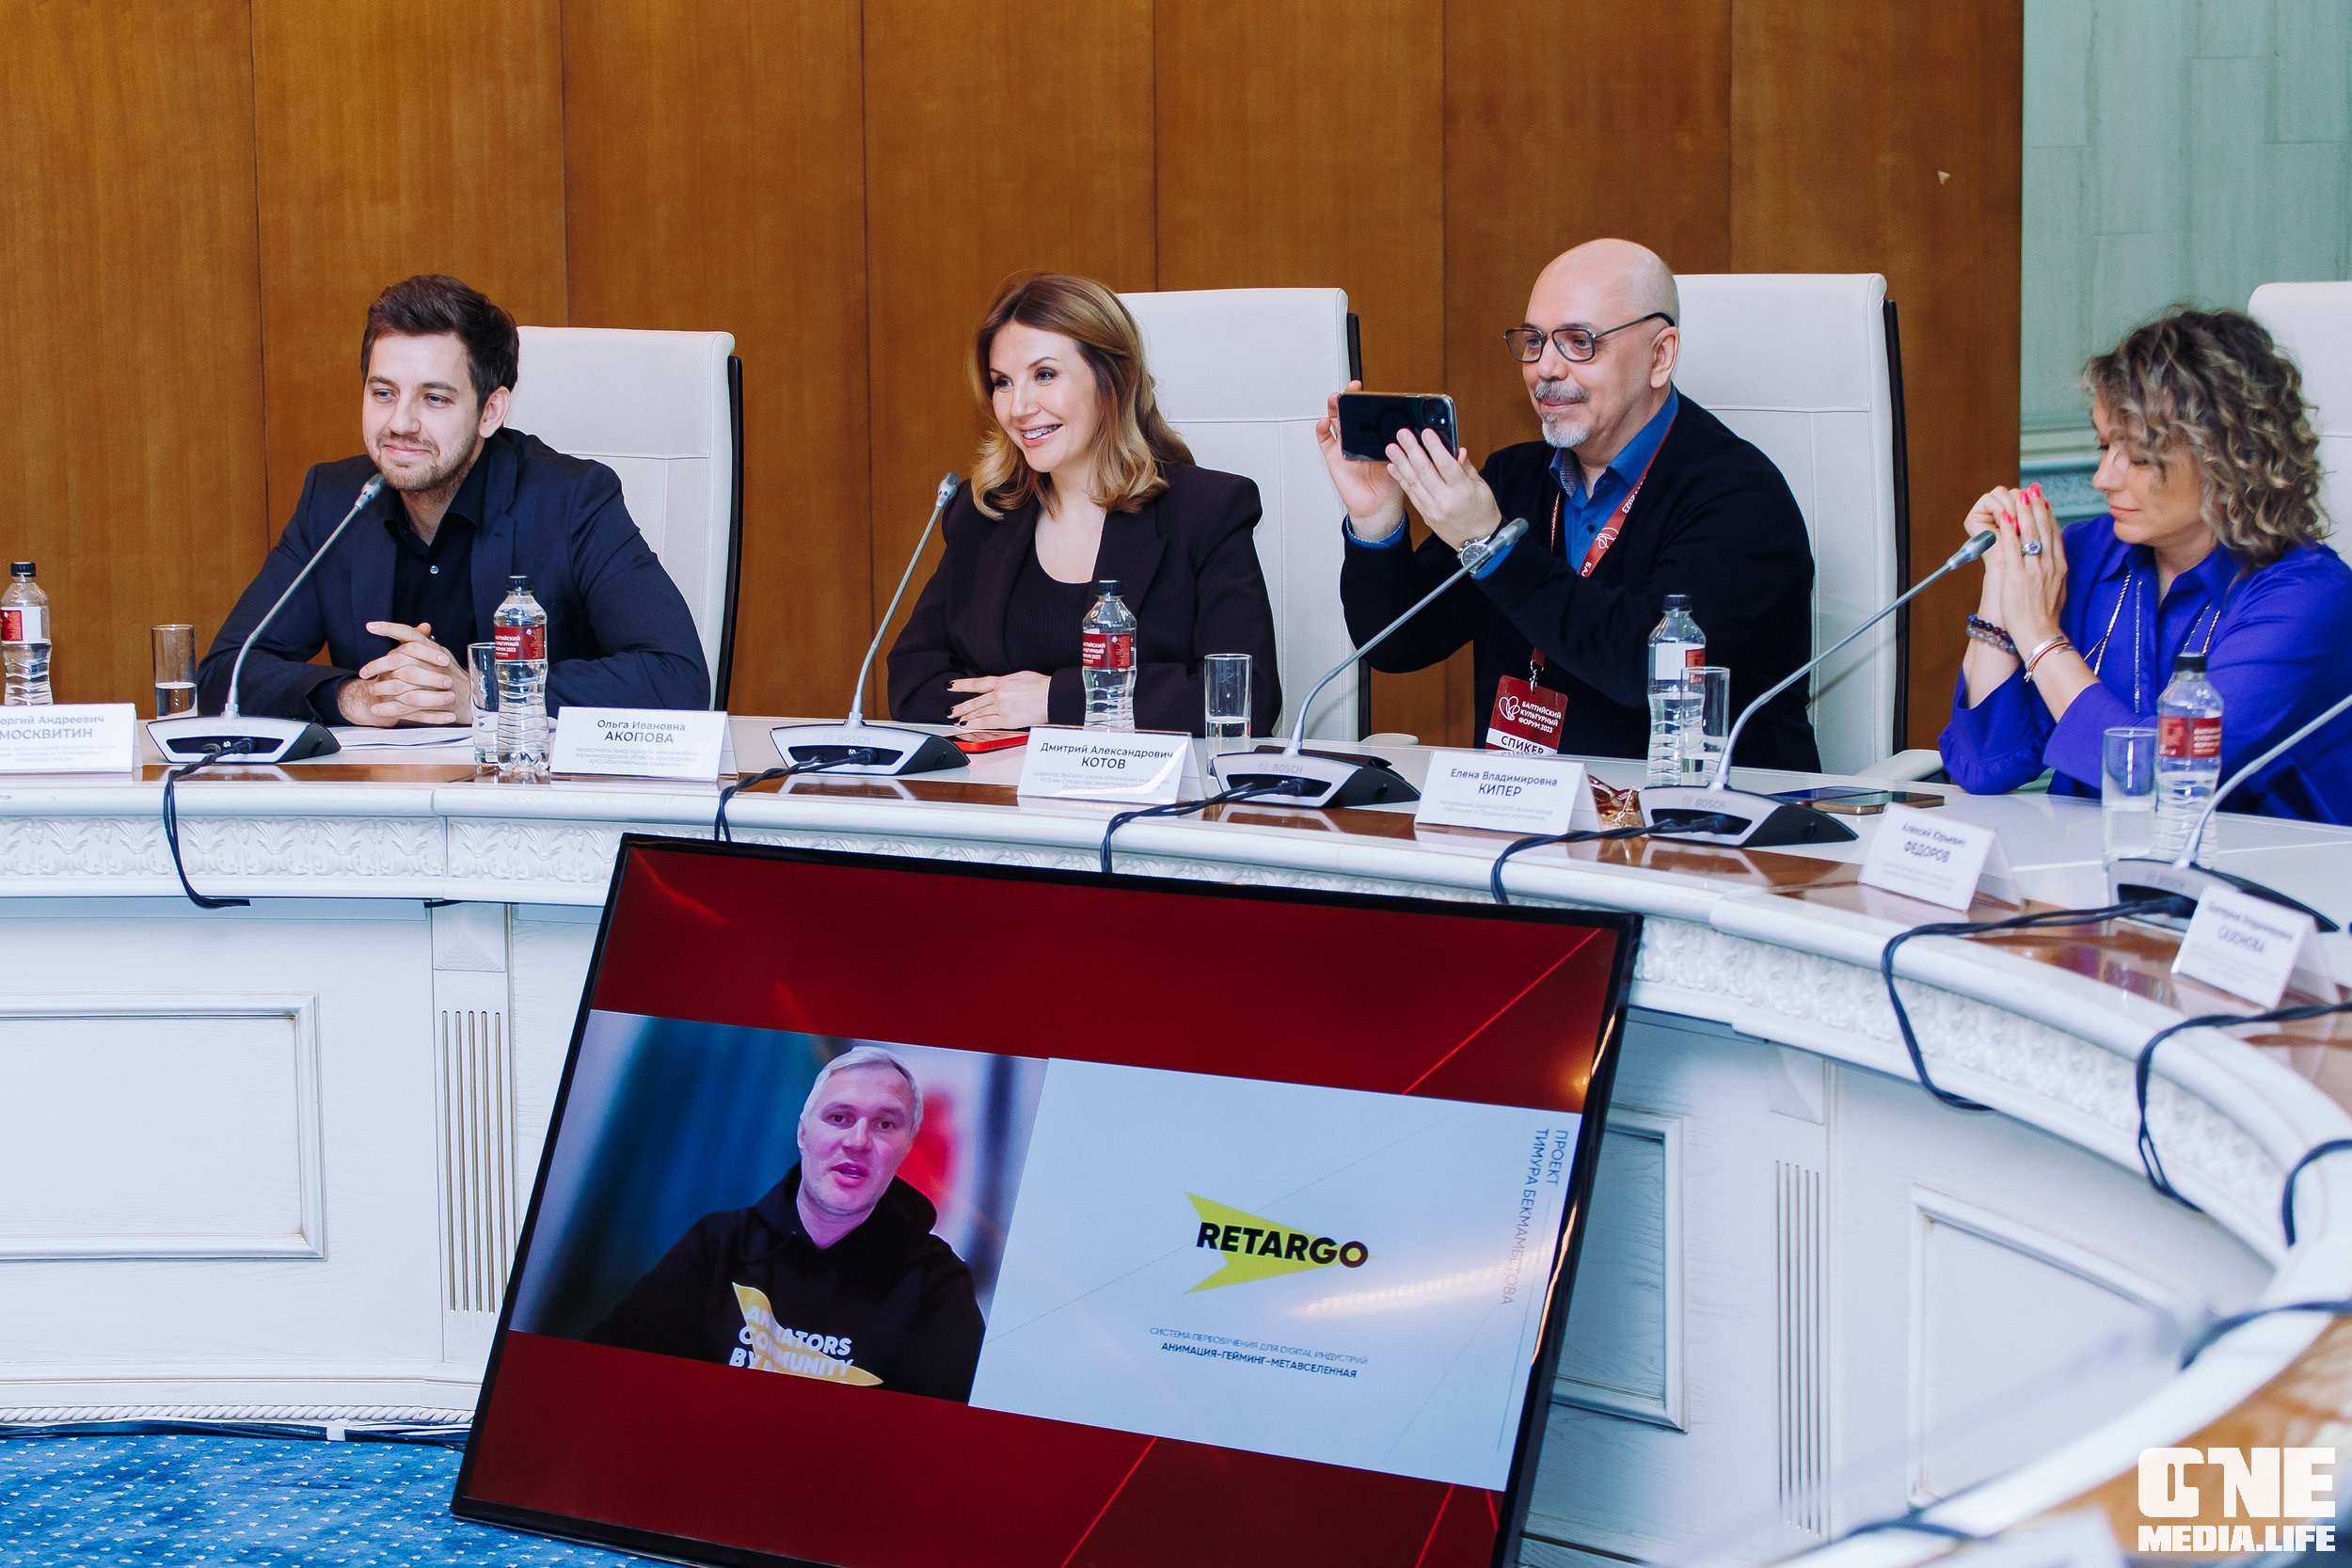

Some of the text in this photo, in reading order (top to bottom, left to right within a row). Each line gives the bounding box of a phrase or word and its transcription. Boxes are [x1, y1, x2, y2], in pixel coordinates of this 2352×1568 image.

[1519, 708, 1559, 727] КУЛЬТУРНЫЙ
[1521, 701, 1562, 720] БАЛТИЙСКИЙ
[0, 716, 104, 726] оргий Андреевич
[596, 720, 686, 732] Ольга Ивановна
[1518, 717, 1553, 734] ФОРУМ 2023
[0, 728, 93, 740] МОСКВИТИН
[604, 731, 675, 744] АКОПОВА
[837, 734, 871, 744] BOSCH
[1040, 742, 1174, 759] Дмитрий Александрович
[1081, 756, 1126, 769] КОТОВ
[1272, 763, 1304, 774] BOSCH
[1451, 768, 1557, 786] Елена Владимировна
[1478, 783, 1522, 797] КИПЕР
[1694, 798, 1725, 810] BOSCH
[1903, 840, 1951, 863] ФЕДОРОВ
[1525, 1128, 1549, 1185] ТИМУРА
[1546, 1129, 1568, 1186] ПРОЕКТ
[1196, 1221, 1369, 1269] RETARGO
[1149, 1326, 1369, 1365] СИСТЕМА ПЕРЕОБУЧЕНИЯ ДЛЯ DIGITAL ИНДУСТРИЙ
